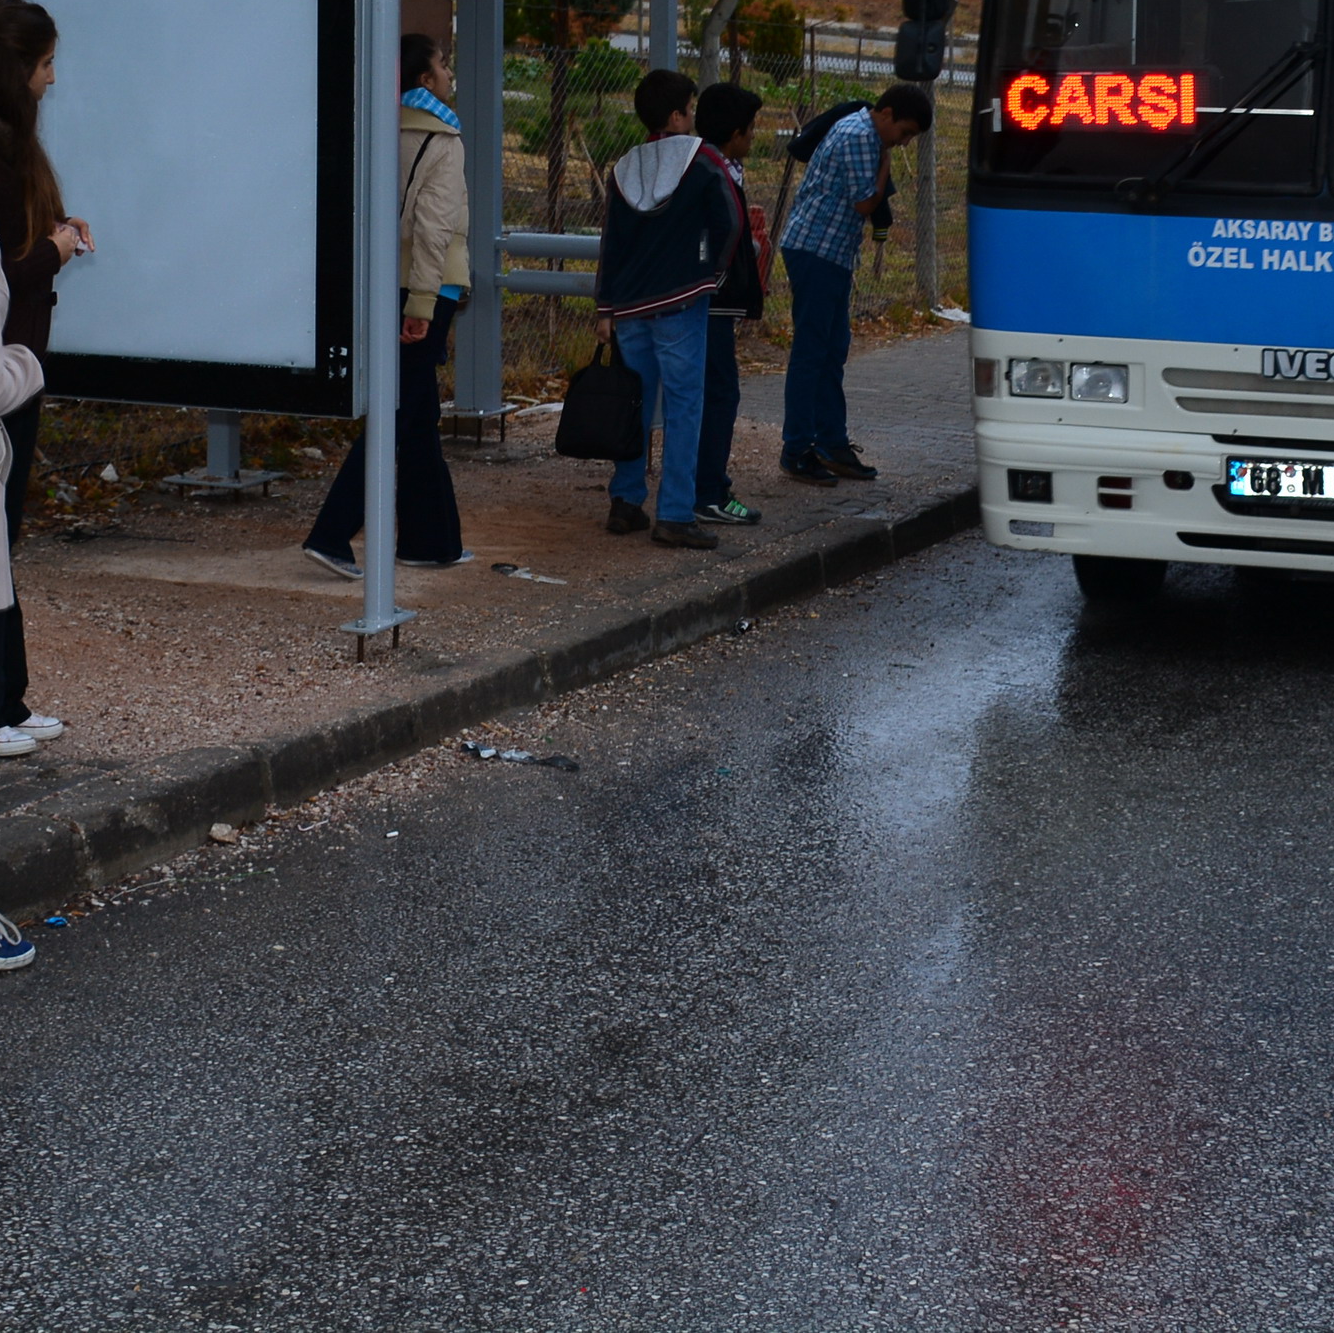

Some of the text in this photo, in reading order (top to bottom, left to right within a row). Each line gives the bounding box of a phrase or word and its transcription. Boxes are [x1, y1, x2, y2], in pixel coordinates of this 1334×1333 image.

[1005, 72, 1197, 131] ÇARŞI
[1211, 218, 1314, 241] AKSARAY
[1187, 241, 1254, 270] ÖZEL
[1261, 248, 1333, 273] HALK
[1249, 466, 1282, 495] 68
[1302, 467, 1325, 495] M
